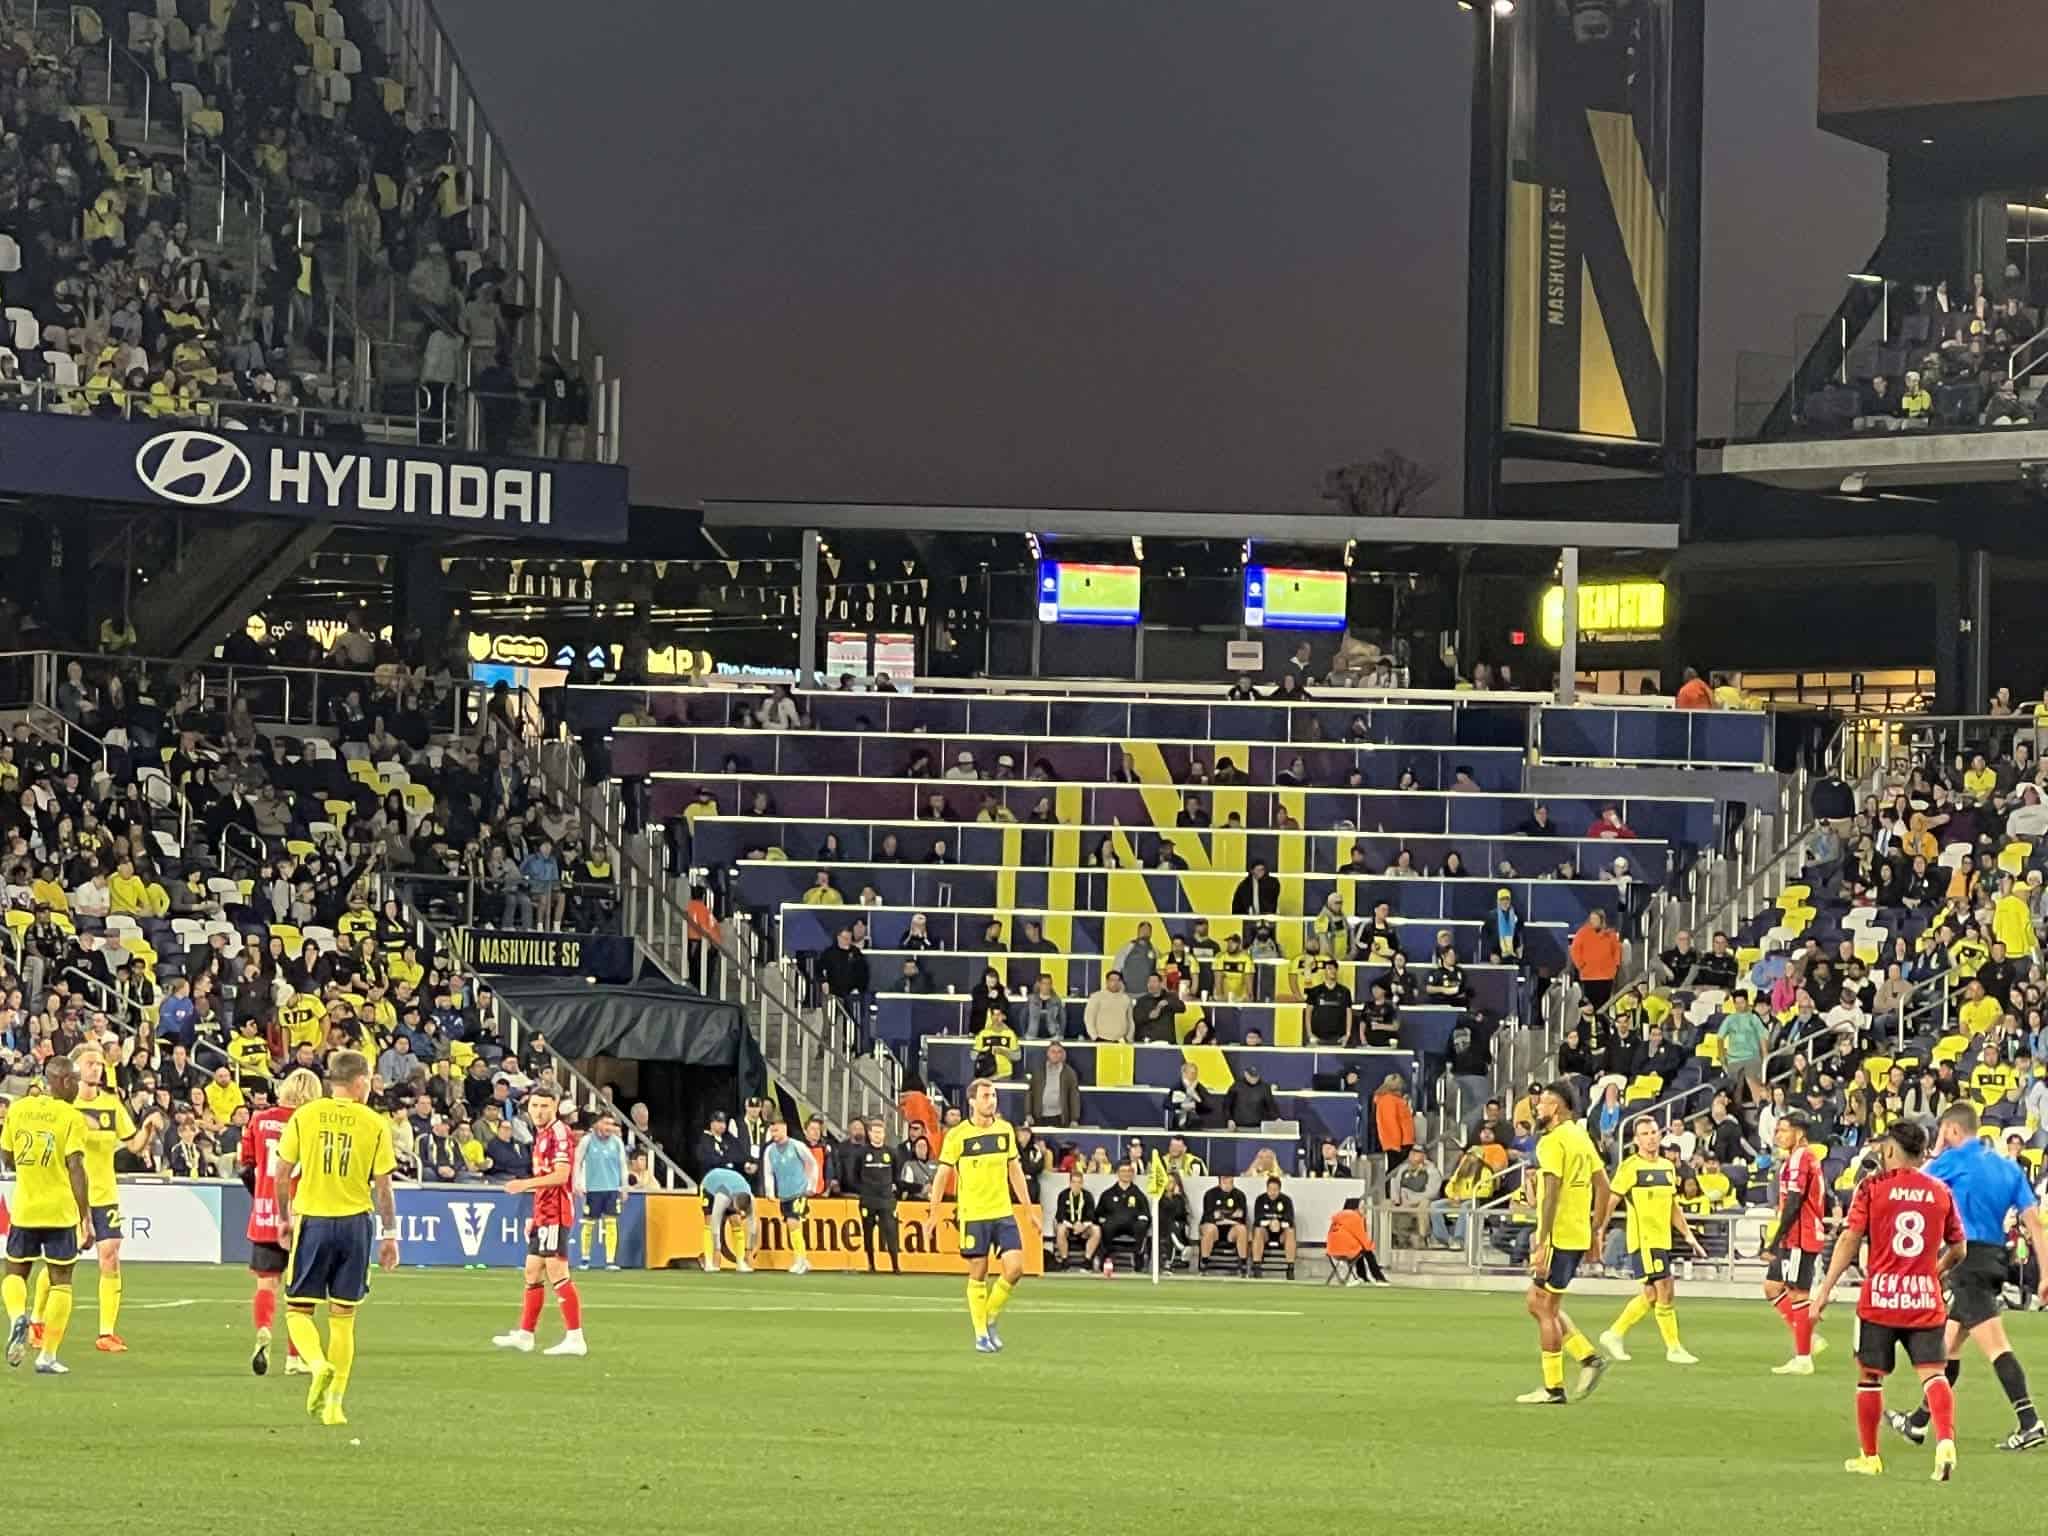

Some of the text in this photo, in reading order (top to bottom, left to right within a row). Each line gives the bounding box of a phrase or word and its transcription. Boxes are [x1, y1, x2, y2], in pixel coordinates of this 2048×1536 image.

[1547, 219, 1567, 325] NASHVILLE
[269, 447, 553, 526] HYUNDAI
[479, 936, 581, 968] NASHVILLE SC
[319, 1111, 356, 1127] BOYD
[15, 1128, 56, 1167] 27
[319, 1130, 353, 1177] 11
[1888, 1187, 1936, 1204] AMAYA
[1891, 1210, 1926, 1258] 8
